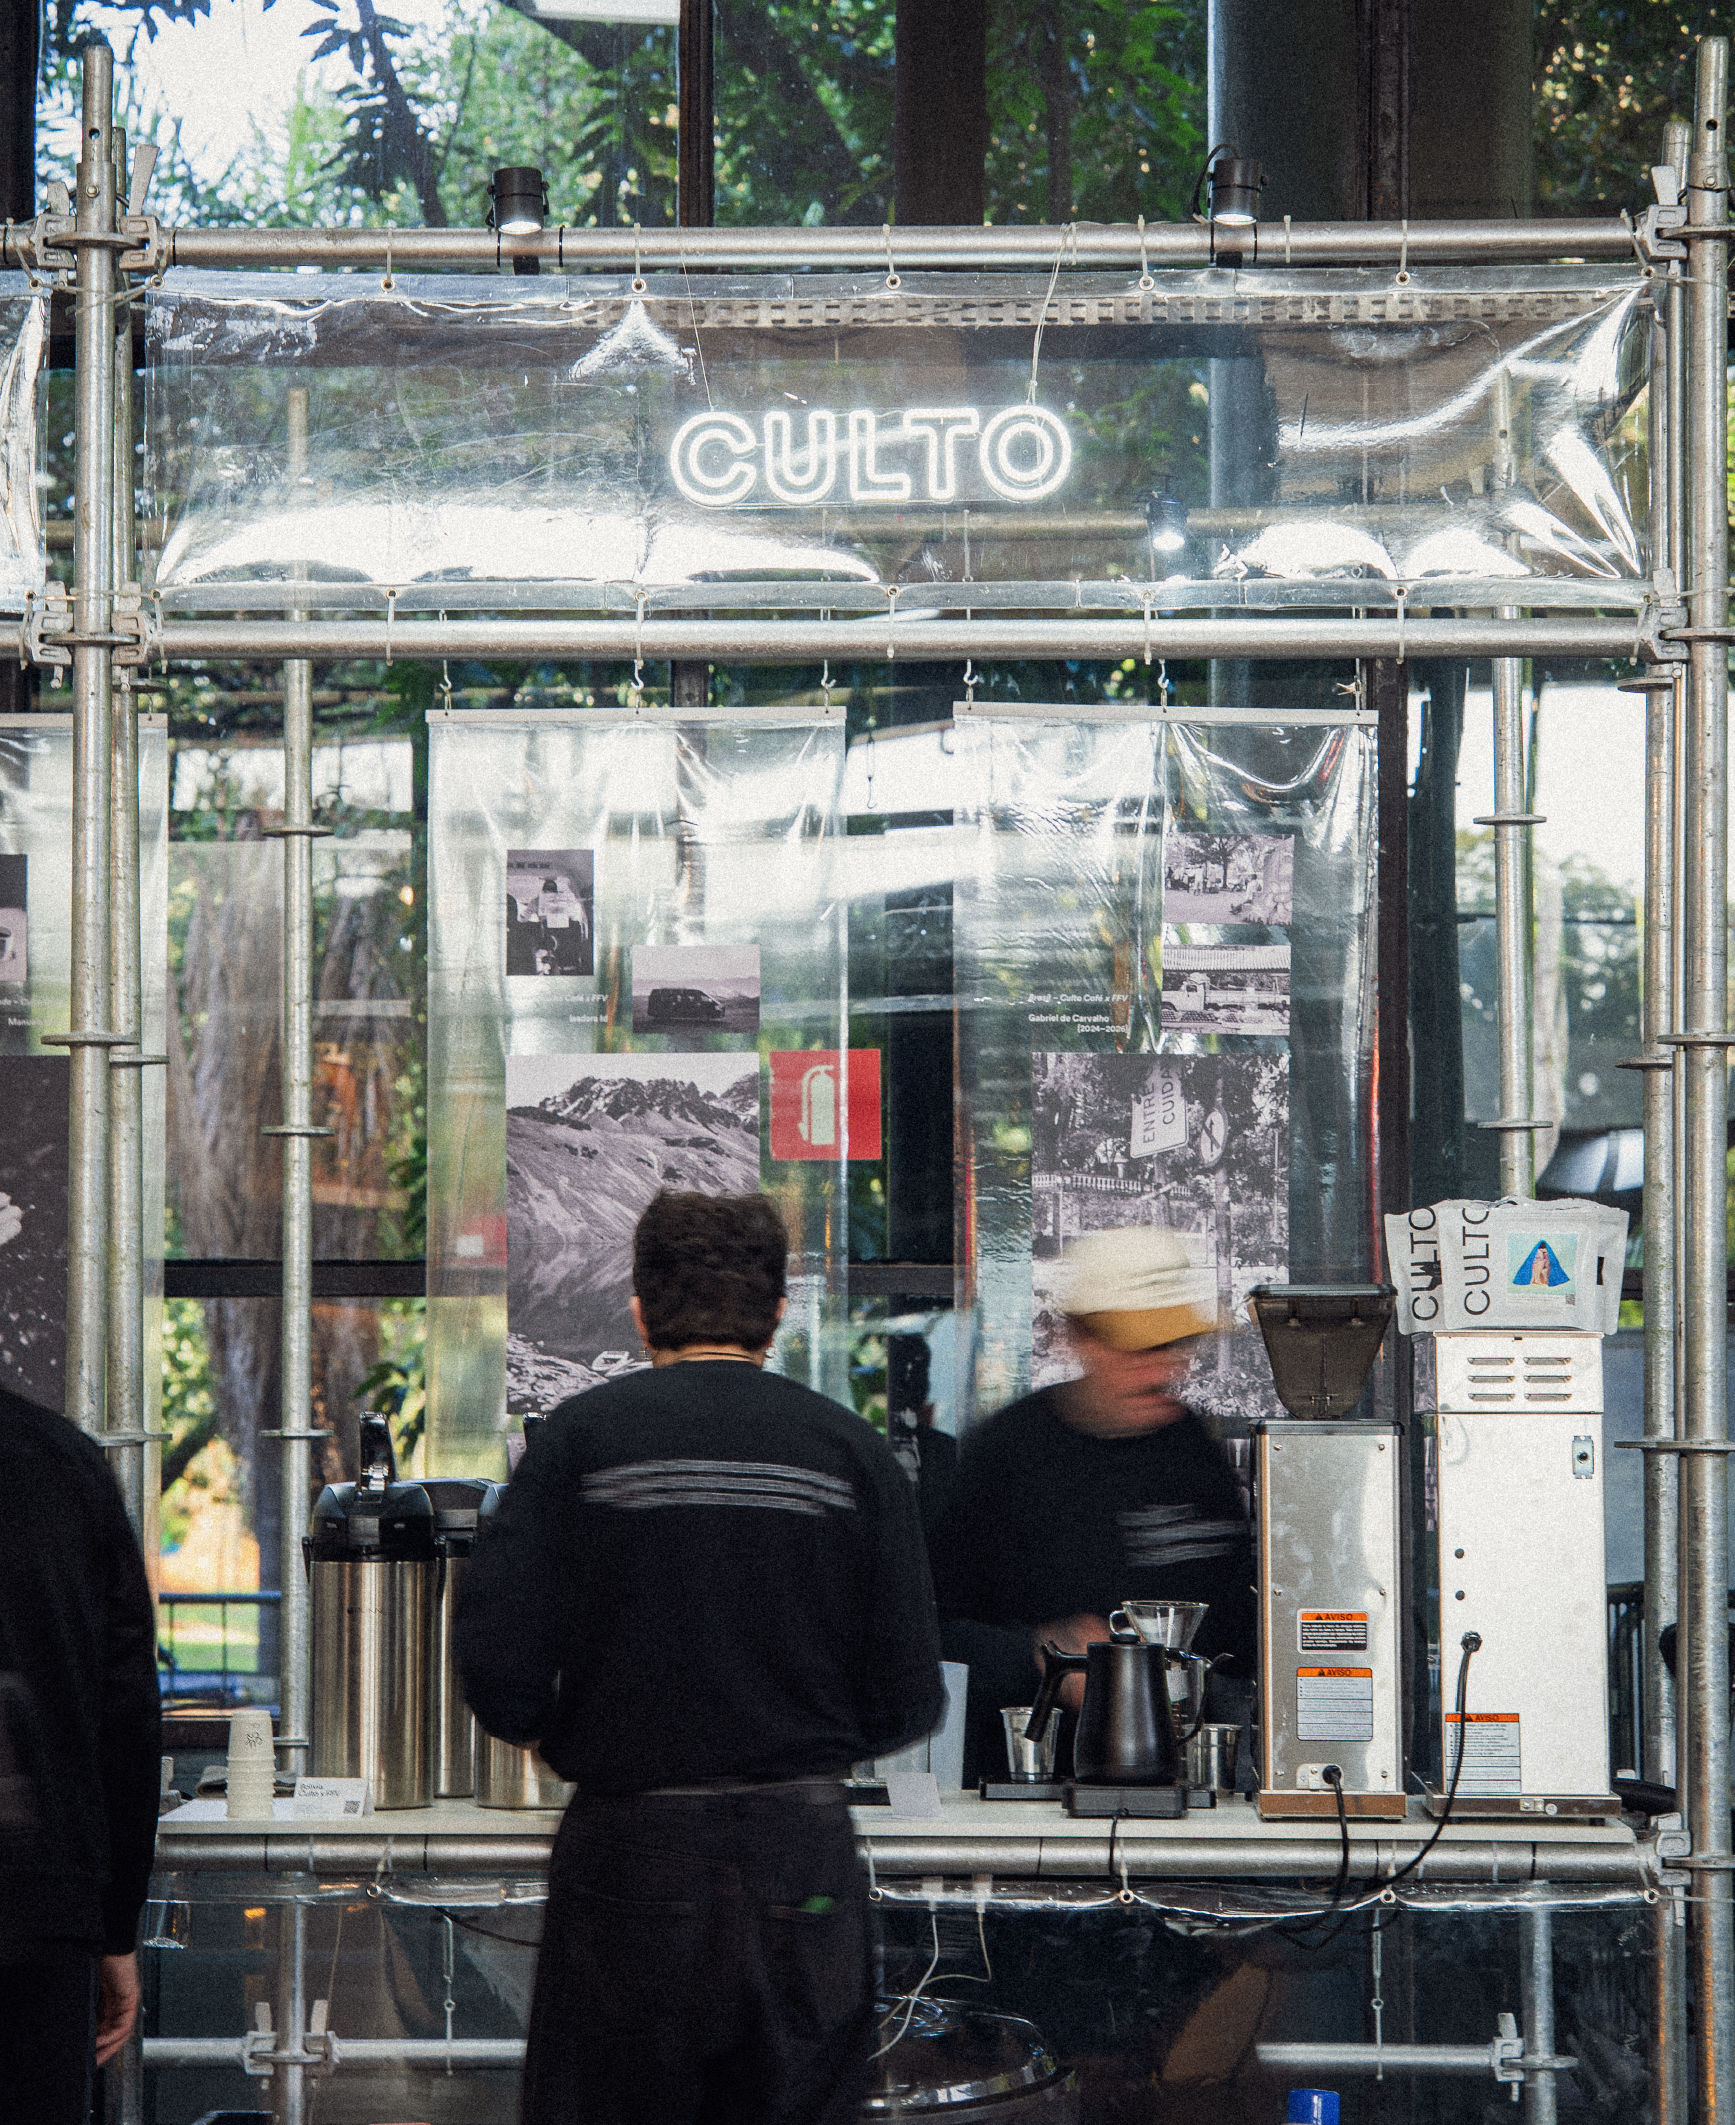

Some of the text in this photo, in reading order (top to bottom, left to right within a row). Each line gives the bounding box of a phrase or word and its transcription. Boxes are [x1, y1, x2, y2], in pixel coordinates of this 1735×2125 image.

[669, 404, 1072, 506] CULTO
[1060, 994, 1082, 1002] Culto
[1083, 993, 1104, 1002] Café
[1111, 994, 1129, 1002] FFV
[1028, 1013, 1110, 1022] Gabriel de Carvalho
[1143, 1083, 1156, 1144] ENTRE
[1408, 1206, 1440, 1321] CULTO
[1325, 1613, 1353, 1621] AVISO
[1326, 1669, 1352, 1677] AVISO
[1475, 1713, 1499, 1721] AVISO
